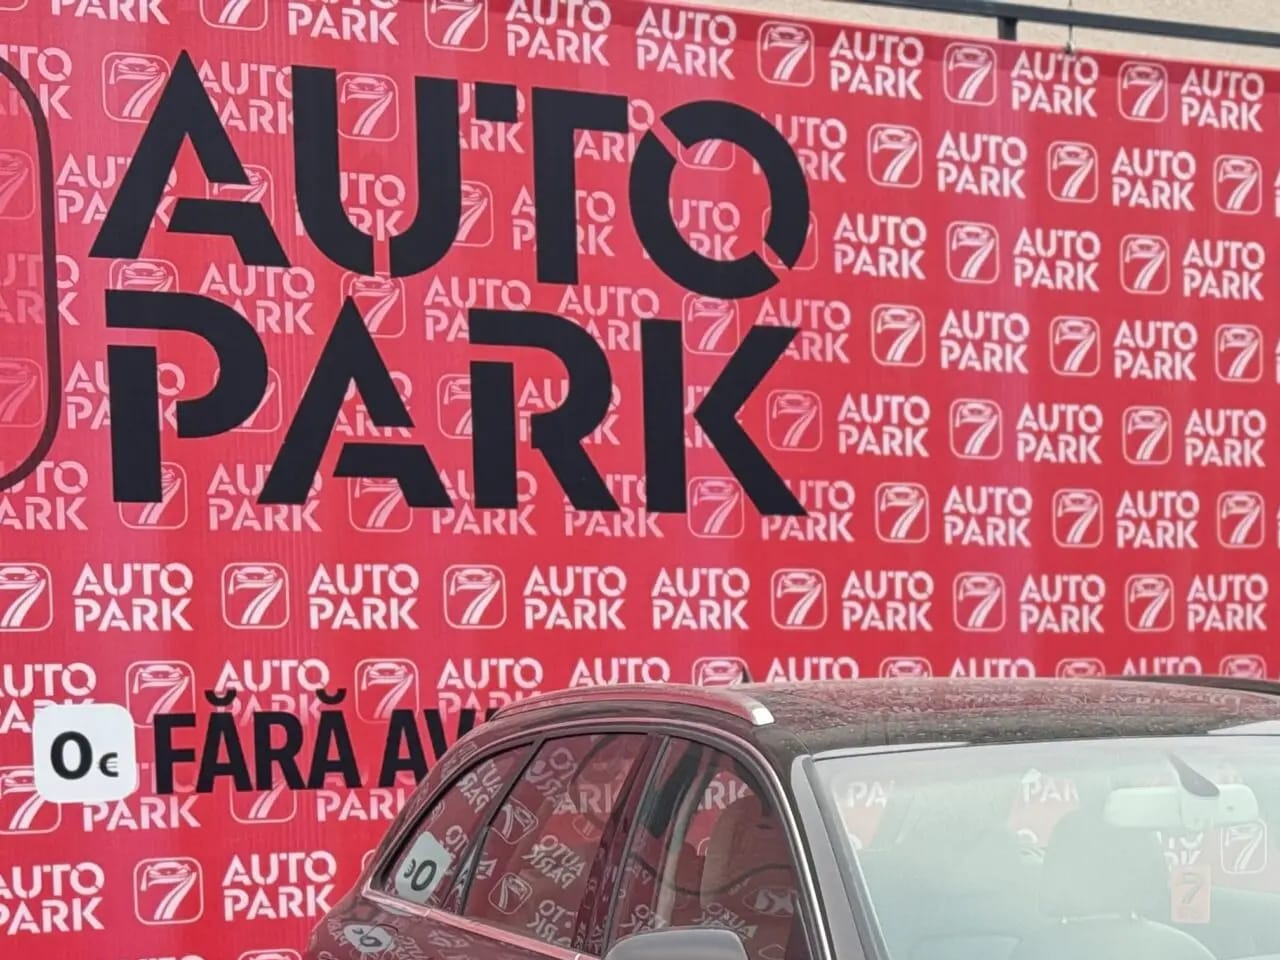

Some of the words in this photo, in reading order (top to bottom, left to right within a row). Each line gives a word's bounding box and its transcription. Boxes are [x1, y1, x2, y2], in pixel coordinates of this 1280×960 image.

[288, 2, 398, 46] PARK
[506, 0, 610, 31] AUTO
[636, 8, 735, 46] AUTO
[507, 24, 609, 66] PARK
[637, 38, 734, 80] PARK
[829, 34, 923, 67] AUTO
[830, 60, 922, 100] PARK
[1011, 50, 1098, 85] AUTO
[1012, 80, 1097, 117] PARK
[1180, 70, 1264, 101] AUTO
[207, 97, 293, 135] ARK
[1182, 96, 1262, 132] PARK
[775, 114, 847, 150] UTO
[937, 131, 1027, 167] AUTO
[1112, 147, 1196, 180] AUTO
[88, 49, 811, 299] AUTO
[938, 161, 1025, 199] PARK
[1112, 177, 1194, 211] PARK
[669, 198, 740, 232] UTO
[834, 213, 926, 247] AUTO
[1013, 228, 1100, 261] AUTO
[1183, 239, 1265, 270] AUTO
[835, 244, 925, 279] PARK
[1014, 257, 1099, 291] PARK
[200, 263, 314, 300] AUTO
[424, 276, 531, 311] AUTO
[1184, 268, 1263, 300] PARK
[558, 285, 660, 318] AUTO
[755, 298, 851, 331] AUTO
[940, 310, 1029, 343] AUTO
[1114, 320, 1197, 350] AUTO
[780, 331, 851, 364] ARK
[941, 339, 1028, 373] PARK
[1115, 349, 1196, 380] PARK
[104, 289, 810, 517] PARK
[838, 394, 930, 426] AUTO
[1016, 403, 1103, 433] AUTO
[1185, 409, 1266, 438] AUTO
[839, 424, 929, 457] PARK
[1017, 432, 1101, 464] PARK
[1185, 437, 1265, 467] PARK
[5, 461, 88, 496] TO
[784, 480, 856, 511] TO
[944, 486, 1032, 516] AUTO
[1116, 491, 1199, 519] AUTO
[0, 496, 88, 531] ARK
[209, 498, 322, 531] PARK
[432, 503, 537, 536] PARK
[564, 505, 664, 538] PARK
[761, 508, 855, 543] PARK
[945, 515, 1031, 547] PARK
[1117, 520, 1198, 548] PARK
[73, 563, 193, 596] AUTO
[308, 564, 419, 595] AUTO
[524, 566, 626, 597] AUTO
[652, 568, 749, 598] AUTO
[842, 570, 934, 600] AUTO
[1019, 575, 1105, 604] AUTO
[1187, 574, 1268, 602] AUTO
[75, 598, 192, 631] PARK
[310, 597, 418, 629] PARK
[525, 598, 625, 629] PARK
[653, 599, 748, 630] PARK
[843, 601, 932, 631] PARK
[1020, 604, 1103, 632] PARK
[1188, 603, 1266, 631] PARK
[215, 659, 330, 694] AUTO
[437, 657, 543, 689] AUTO
[569, 657, 671, 687] AUTO
[766, 656, 859, 681] AUTO
[949, 658, 1035, 679] AUTO
[1122, 657, 1202, 676] AUTO
[153, 688, 363, 796] FĂRĂ
[83, 795, 201, 832] PARK
[316, 794, 404, 823] PAR
[223, 851, 336, 886] AUTO
[224, 884, 336, 923] PARK
